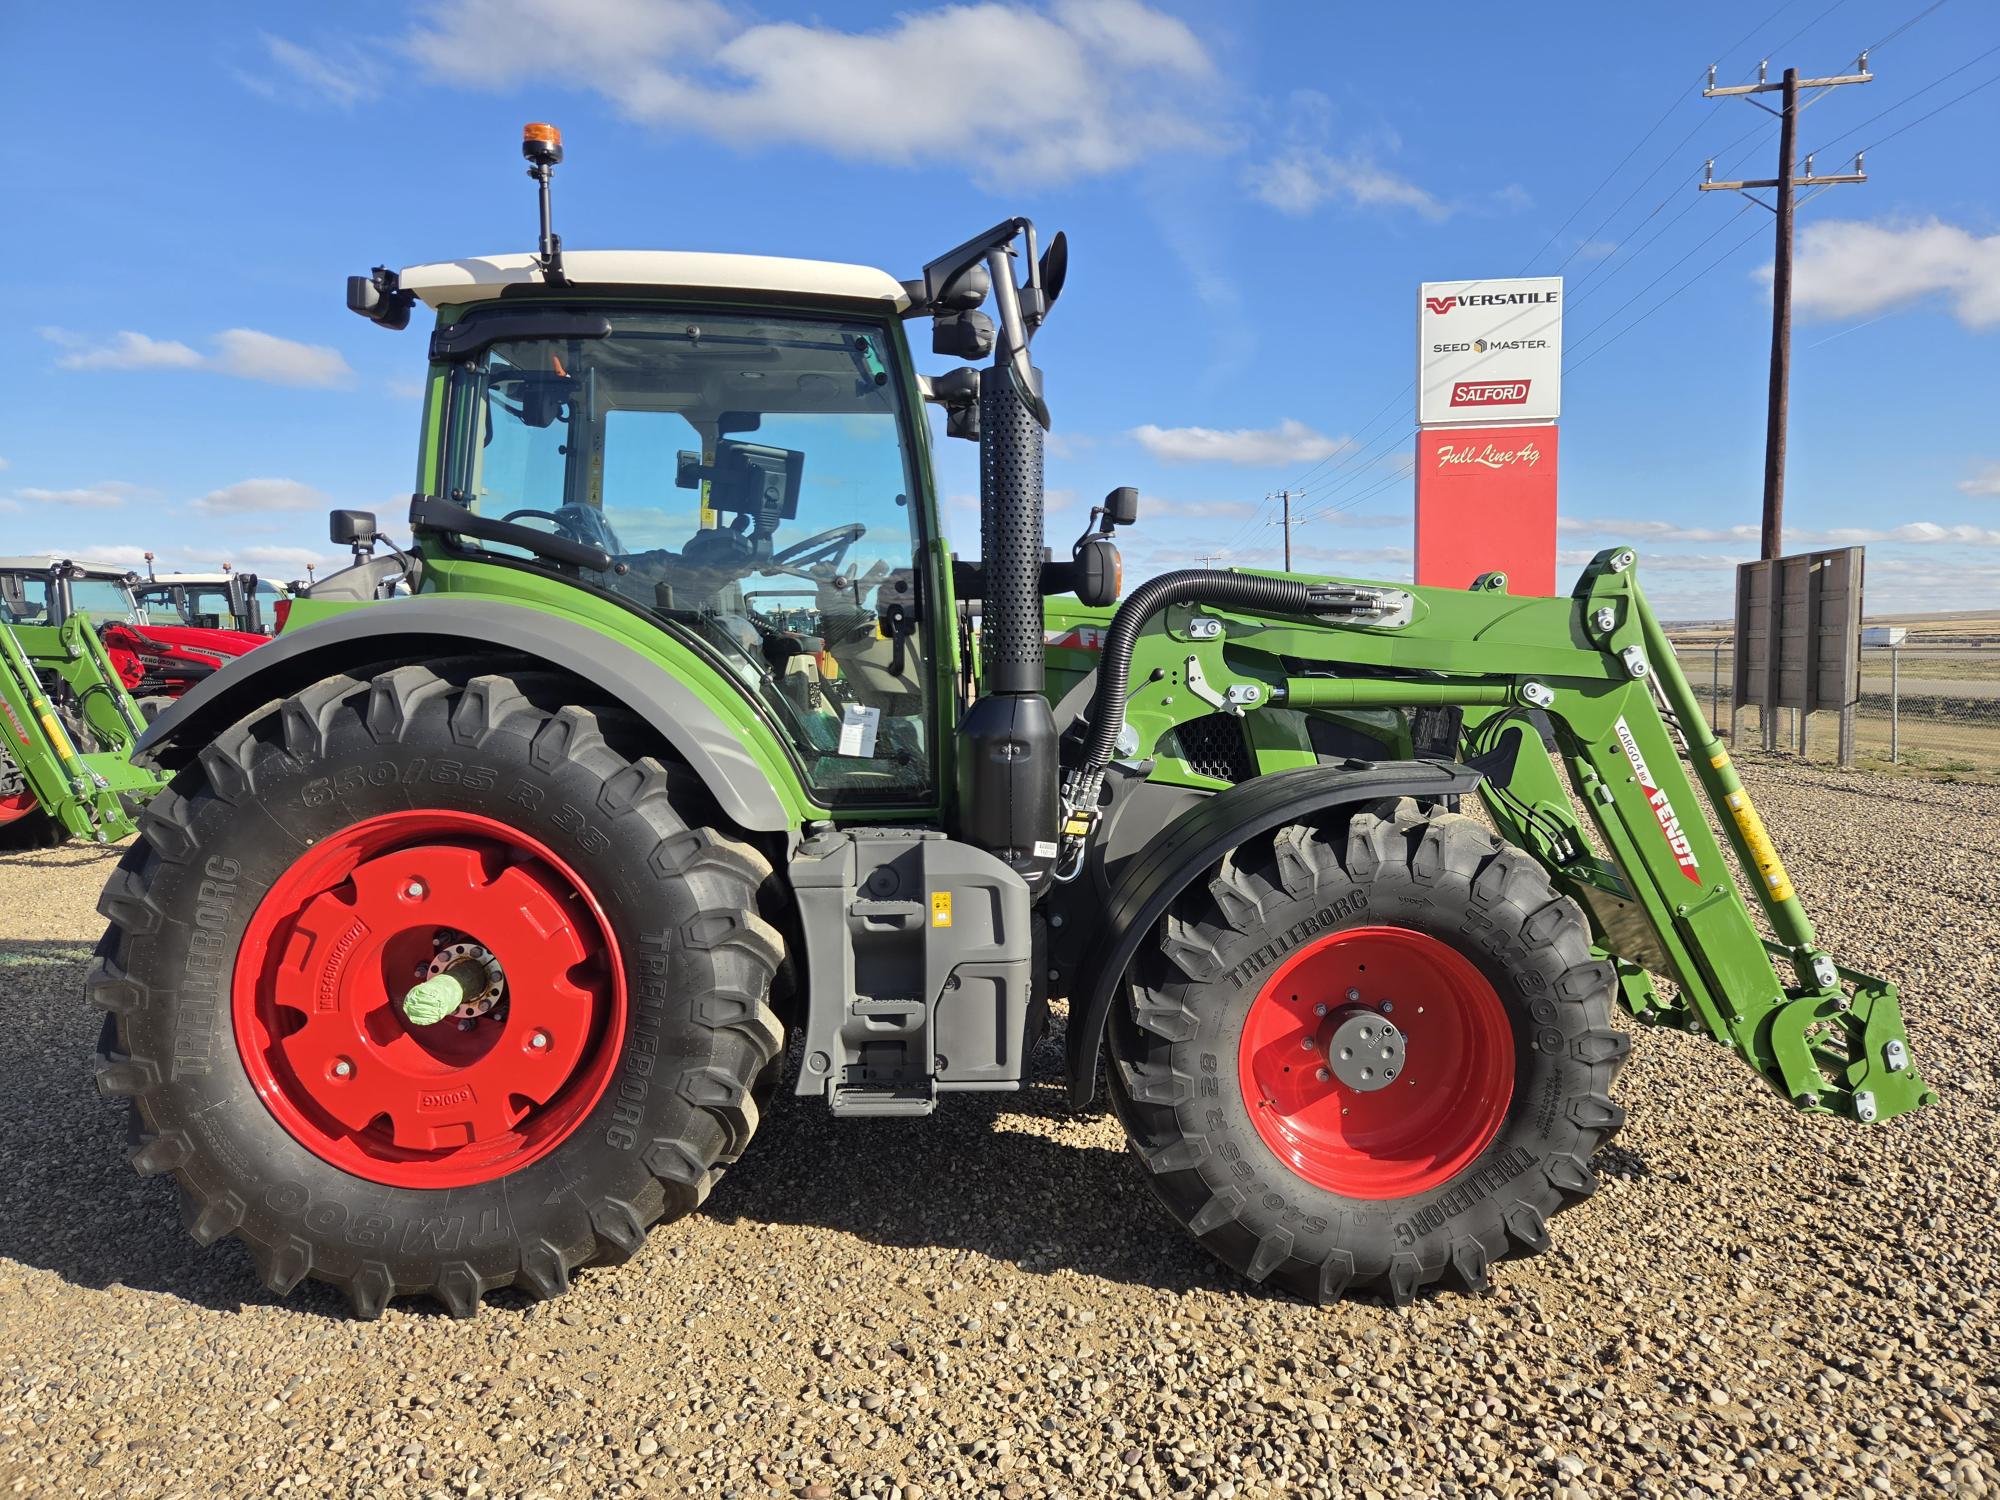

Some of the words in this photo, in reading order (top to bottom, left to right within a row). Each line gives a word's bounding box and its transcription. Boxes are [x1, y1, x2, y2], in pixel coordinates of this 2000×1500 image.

[1457, 291, 1558, 307] VERSATILE
[1433, 342, 1471, 353] SEED
[1490, 340, 1546, 350] MASTER
[1455, 383, 1527, 402] SALFORD
[1437, 445, 1474, 469] Full
[1475, 443, 1513, 469] Line
[1511, 442, 1541, 467] Ag
[140, 657, 176, 667] FERGUSON
[1617, 726, 1640, 762] CARGO
[301, 758, 499, 809] 650/65
[508, 778, 545, 812] R
[552, 803, 611, 856] 38
[1649, 788, 1700, 868] FENDT
[171, 854, 242, 1082] TRELLEBORG
[1222, 888, 1369, 991] TRELLEBORG
[1459, 908, 1565, 1056] TM800
[604, 927, 672, 1152] TRELLEBORG
[1199, 1052, 1220, 1098] 28
[1206, 1106, 1229, 1132] R
[265, 1180, 510, 1256] TM800
[1218, 1140, 1328, 1235] 540/55
[1394, 1143, 1541, 1247] TRELLEBORG
